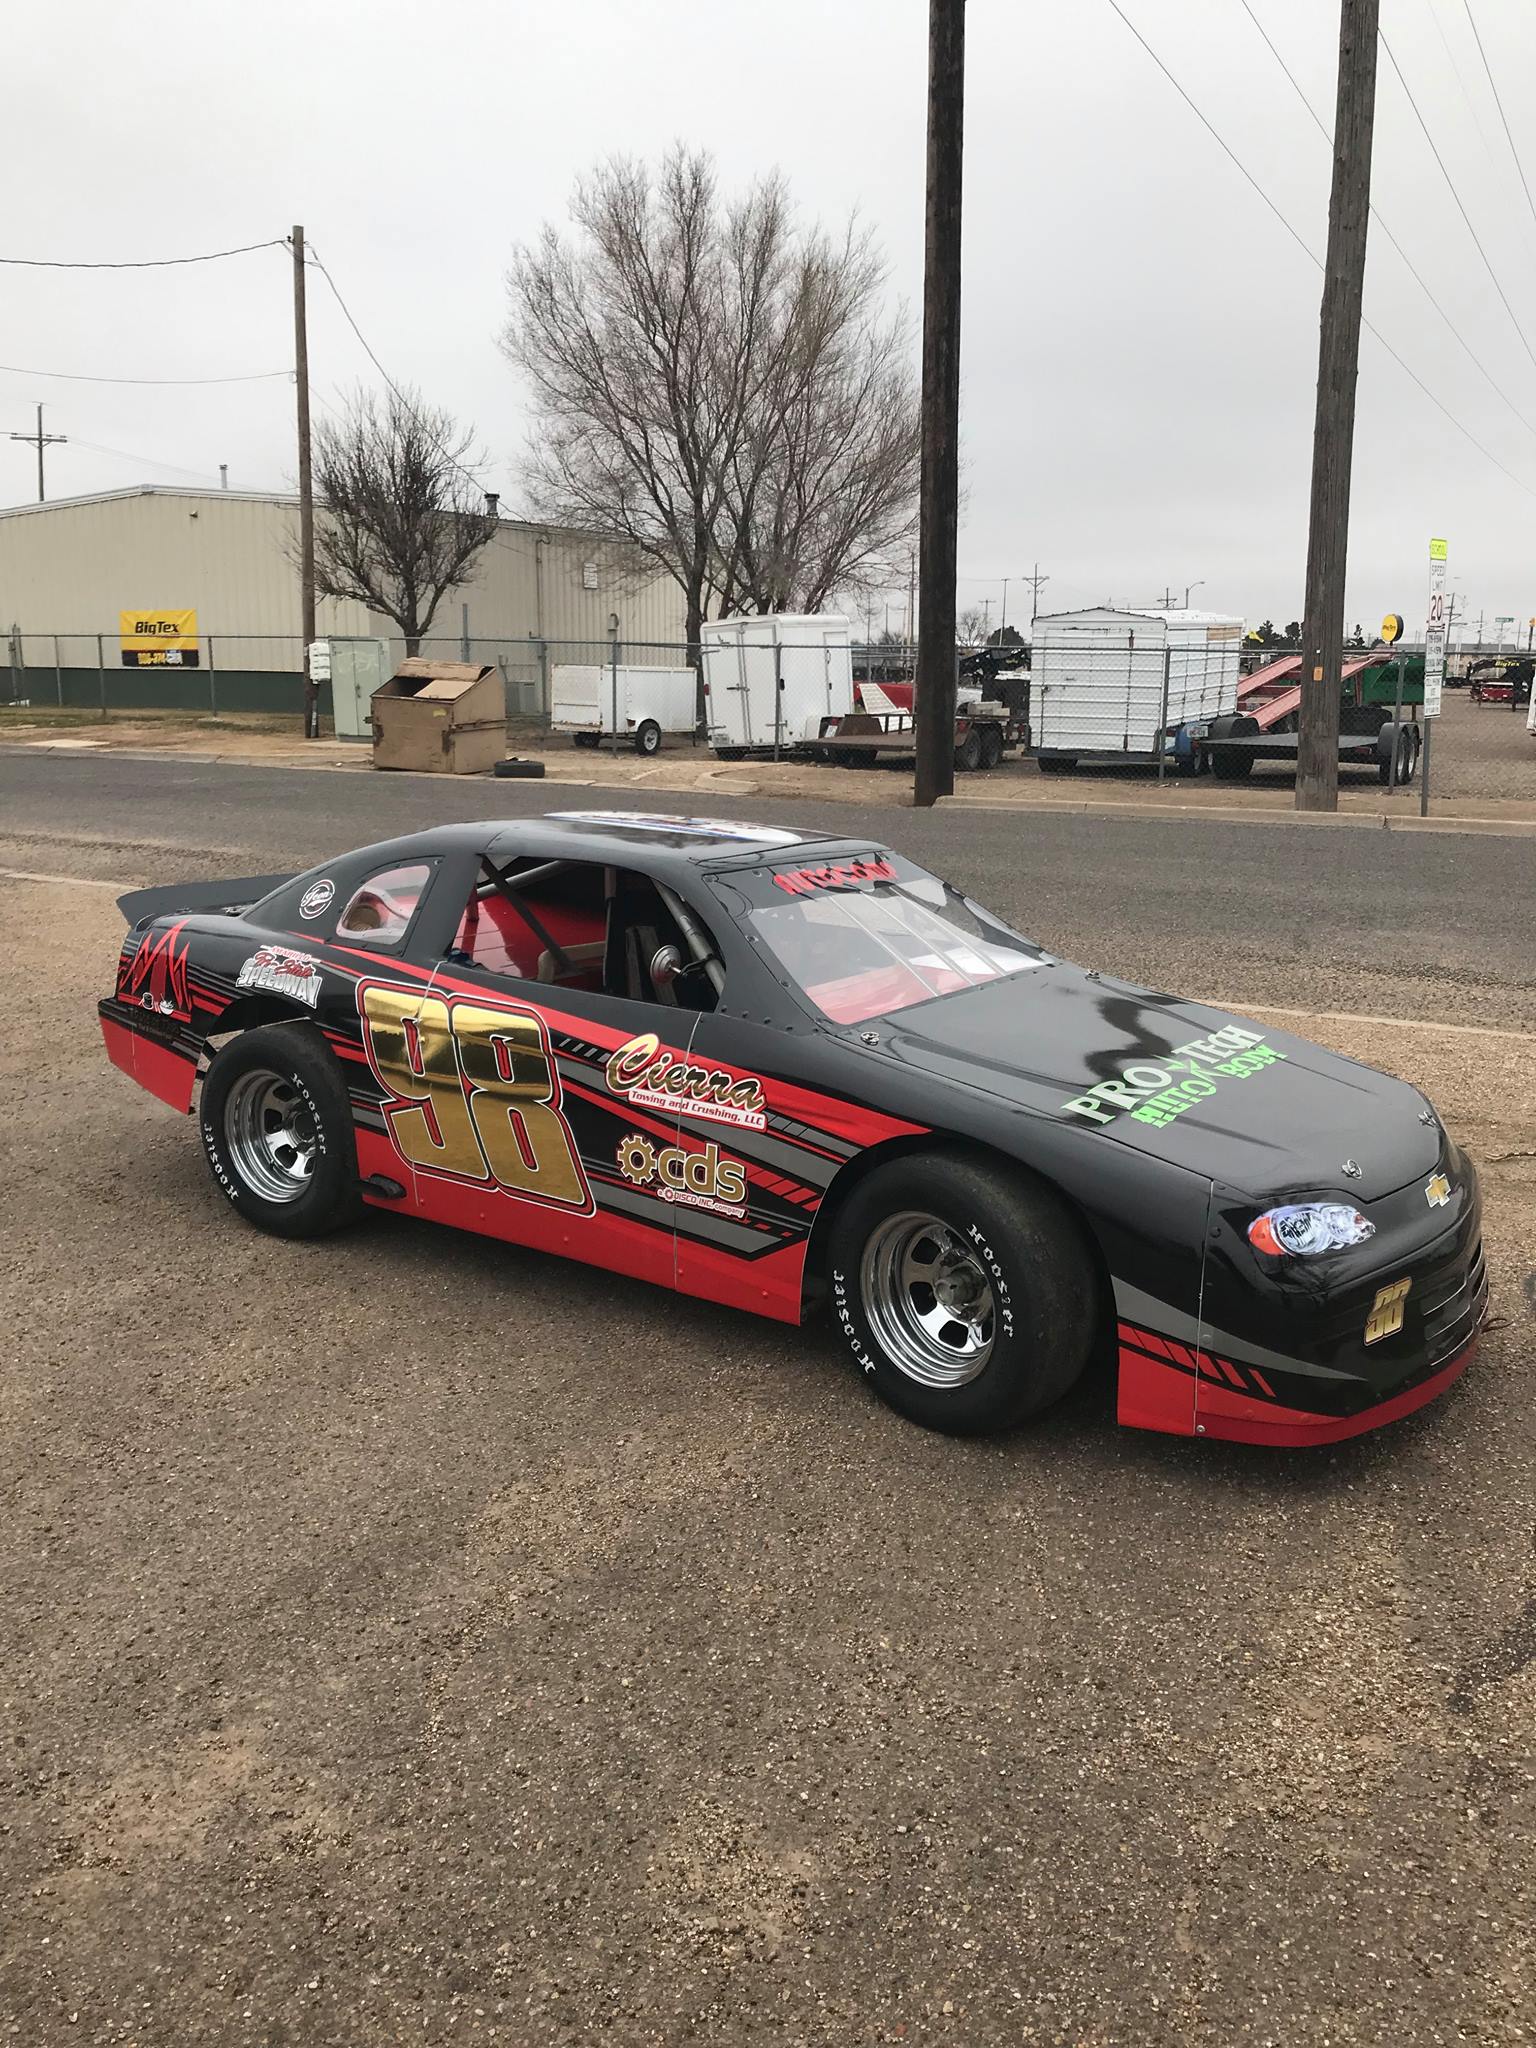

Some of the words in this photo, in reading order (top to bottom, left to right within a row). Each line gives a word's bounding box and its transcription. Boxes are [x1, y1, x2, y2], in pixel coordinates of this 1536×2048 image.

[1431, 595, 1443, 621] 20
[236, 958, 323, 1009] SPEEDWAY
[357, 977, 596, 1218] 98
[607, 1033, 766, 1112] Cierra
[1061, 1066, 1172, 1125] PRO
[1171, 1024, 1266, 1064] TECH
[1131, 1079, 1217, 1129] AUTO
[1213, 1044, 1289, 1079] BODY
[631, 1090, 666, 1107] Towing
[668, 1101, 689, 1111] and
[691, 1102, 741, 1122] Crushing,
[744, 1114, 763, 1126] LLC
[658, 1143, 746, 1203] cds
[674, 1192, 697, 1204] DISCO
[699, 1196, 714, 1208] INC.
[714, 1203, 745, 1218] company
